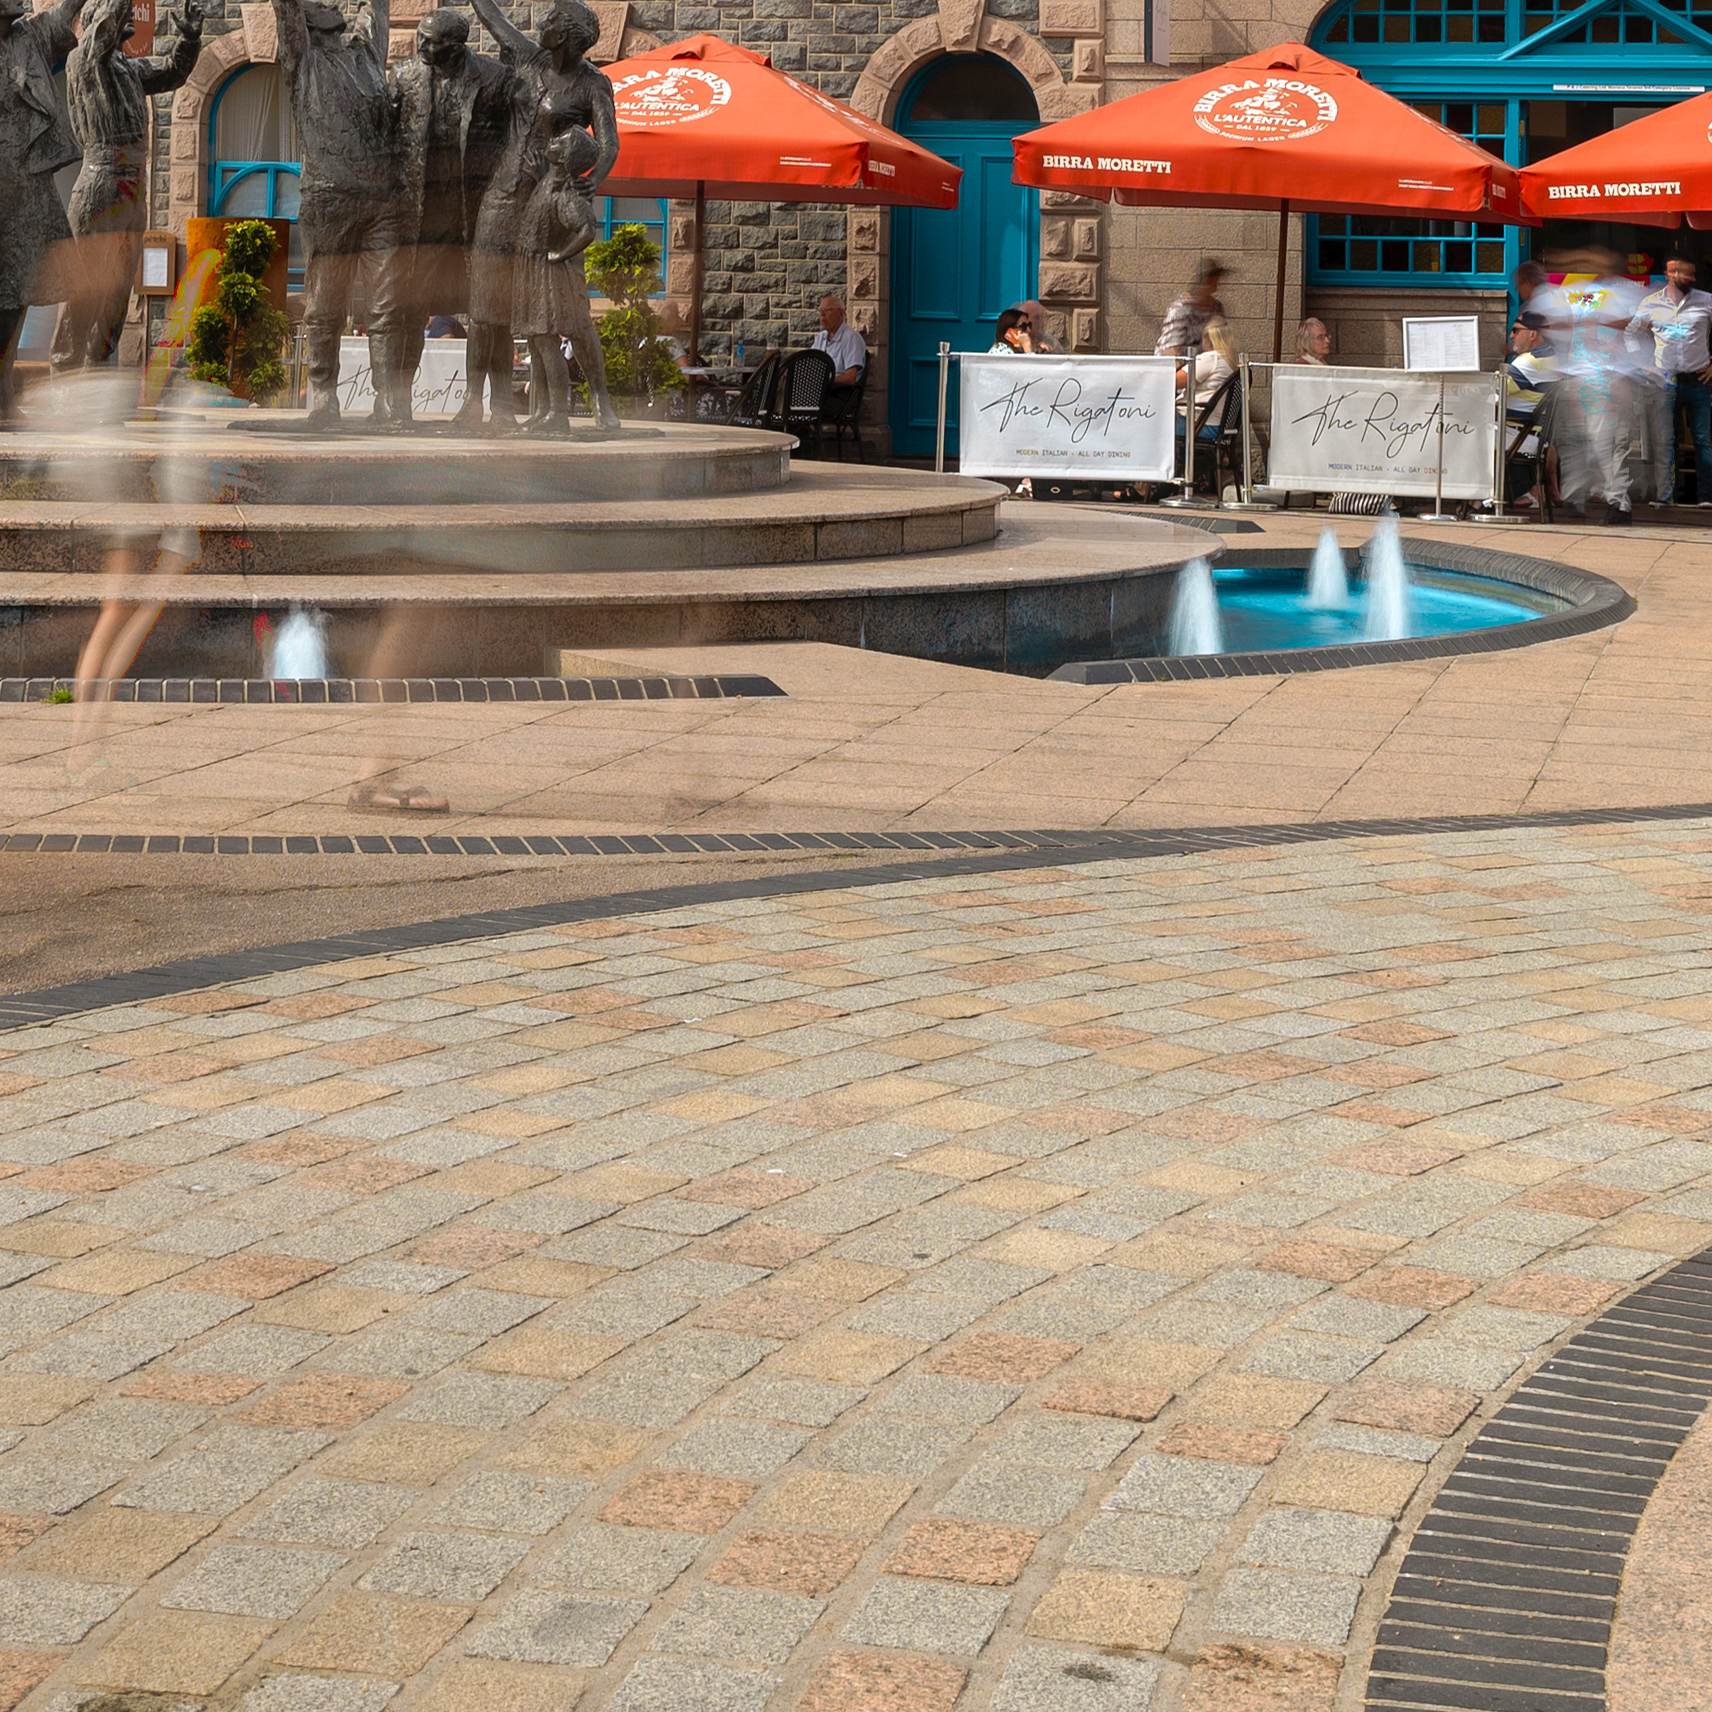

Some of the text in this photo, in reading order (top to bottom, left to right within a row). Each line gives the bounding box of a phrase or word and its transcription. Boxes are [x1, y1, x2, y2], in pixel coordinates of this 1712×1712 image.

[612, 67, 732, 105] RRA MORETTI
[1192, 78, 1338, 122] BIRRA MORETTI
[1213, 114, 1307, 128] L'AUTENTICA
[1219, 131, 1255, 142] PREMIUM
[1043, 155, 1172, 174] BIRRA MORETTI
[1548, 181, 1681, 199] BIRRA MORETTI
[979, 377, 1157, 444] The Rigatoni
[1291, 390, 1476, 459] The Rigatoni
[1042, 449, 1068, 457] ITALIAN
[1328, 463, 1352, 471] MODERN
[1424, 467, 1448, 475] DINNG
